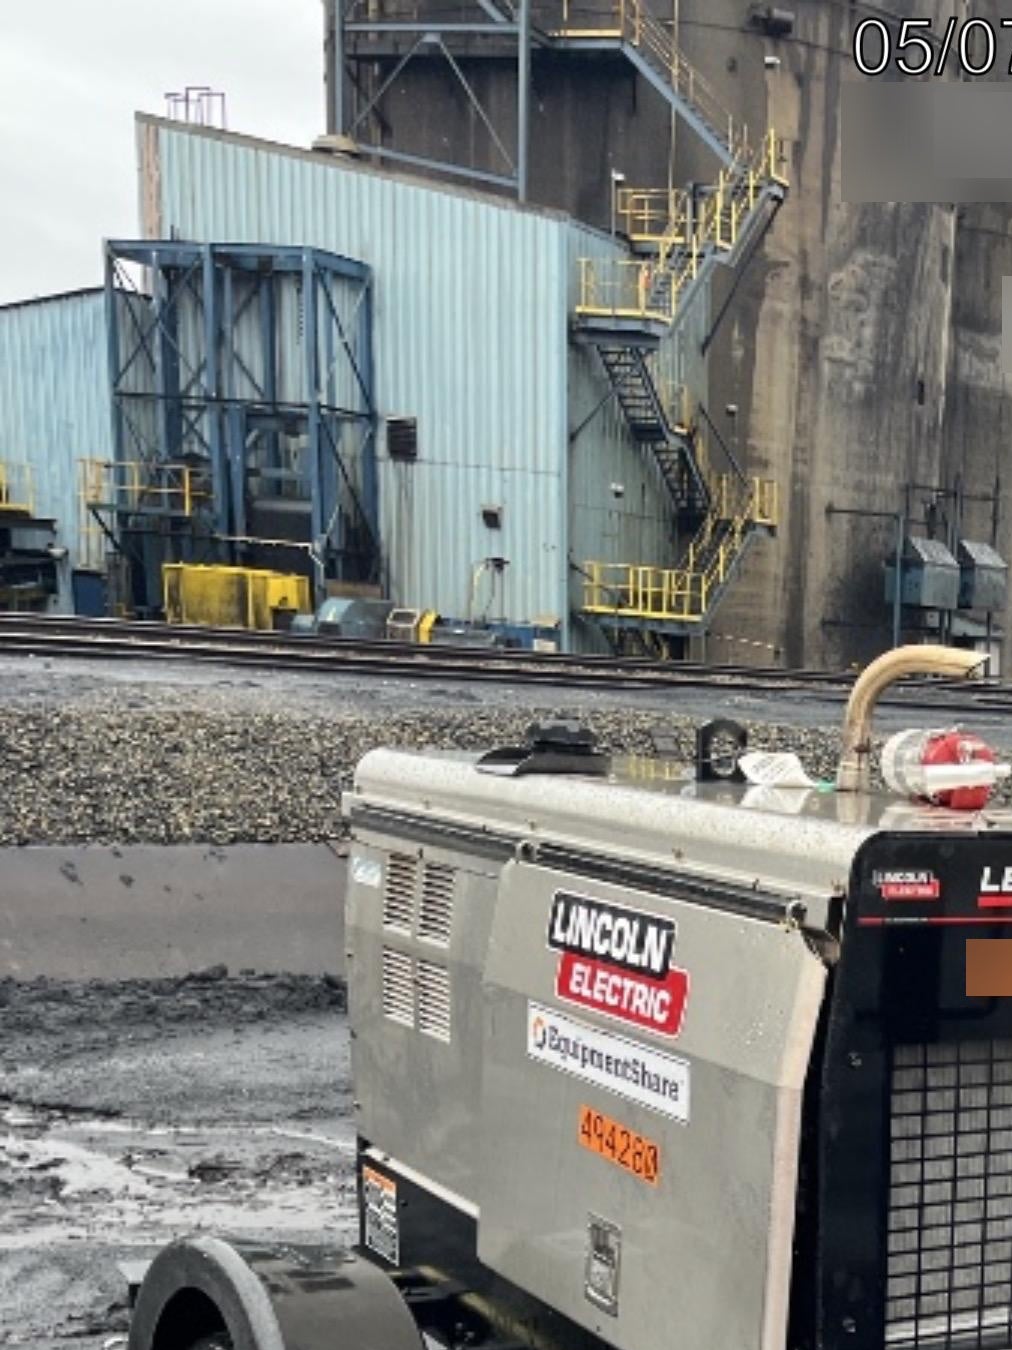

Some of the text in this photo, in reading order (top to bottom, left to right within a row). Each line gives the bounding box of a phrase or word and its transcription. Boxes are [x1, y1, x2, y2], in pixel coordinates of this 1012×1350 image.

[552, 901, 669, 974] LINCOLN
[569, 962, 672, 1025] ELECTRIC
[547, 1024, 680, 1102] EquipmentShare
[580, 1110, 658, 1183] 494280
